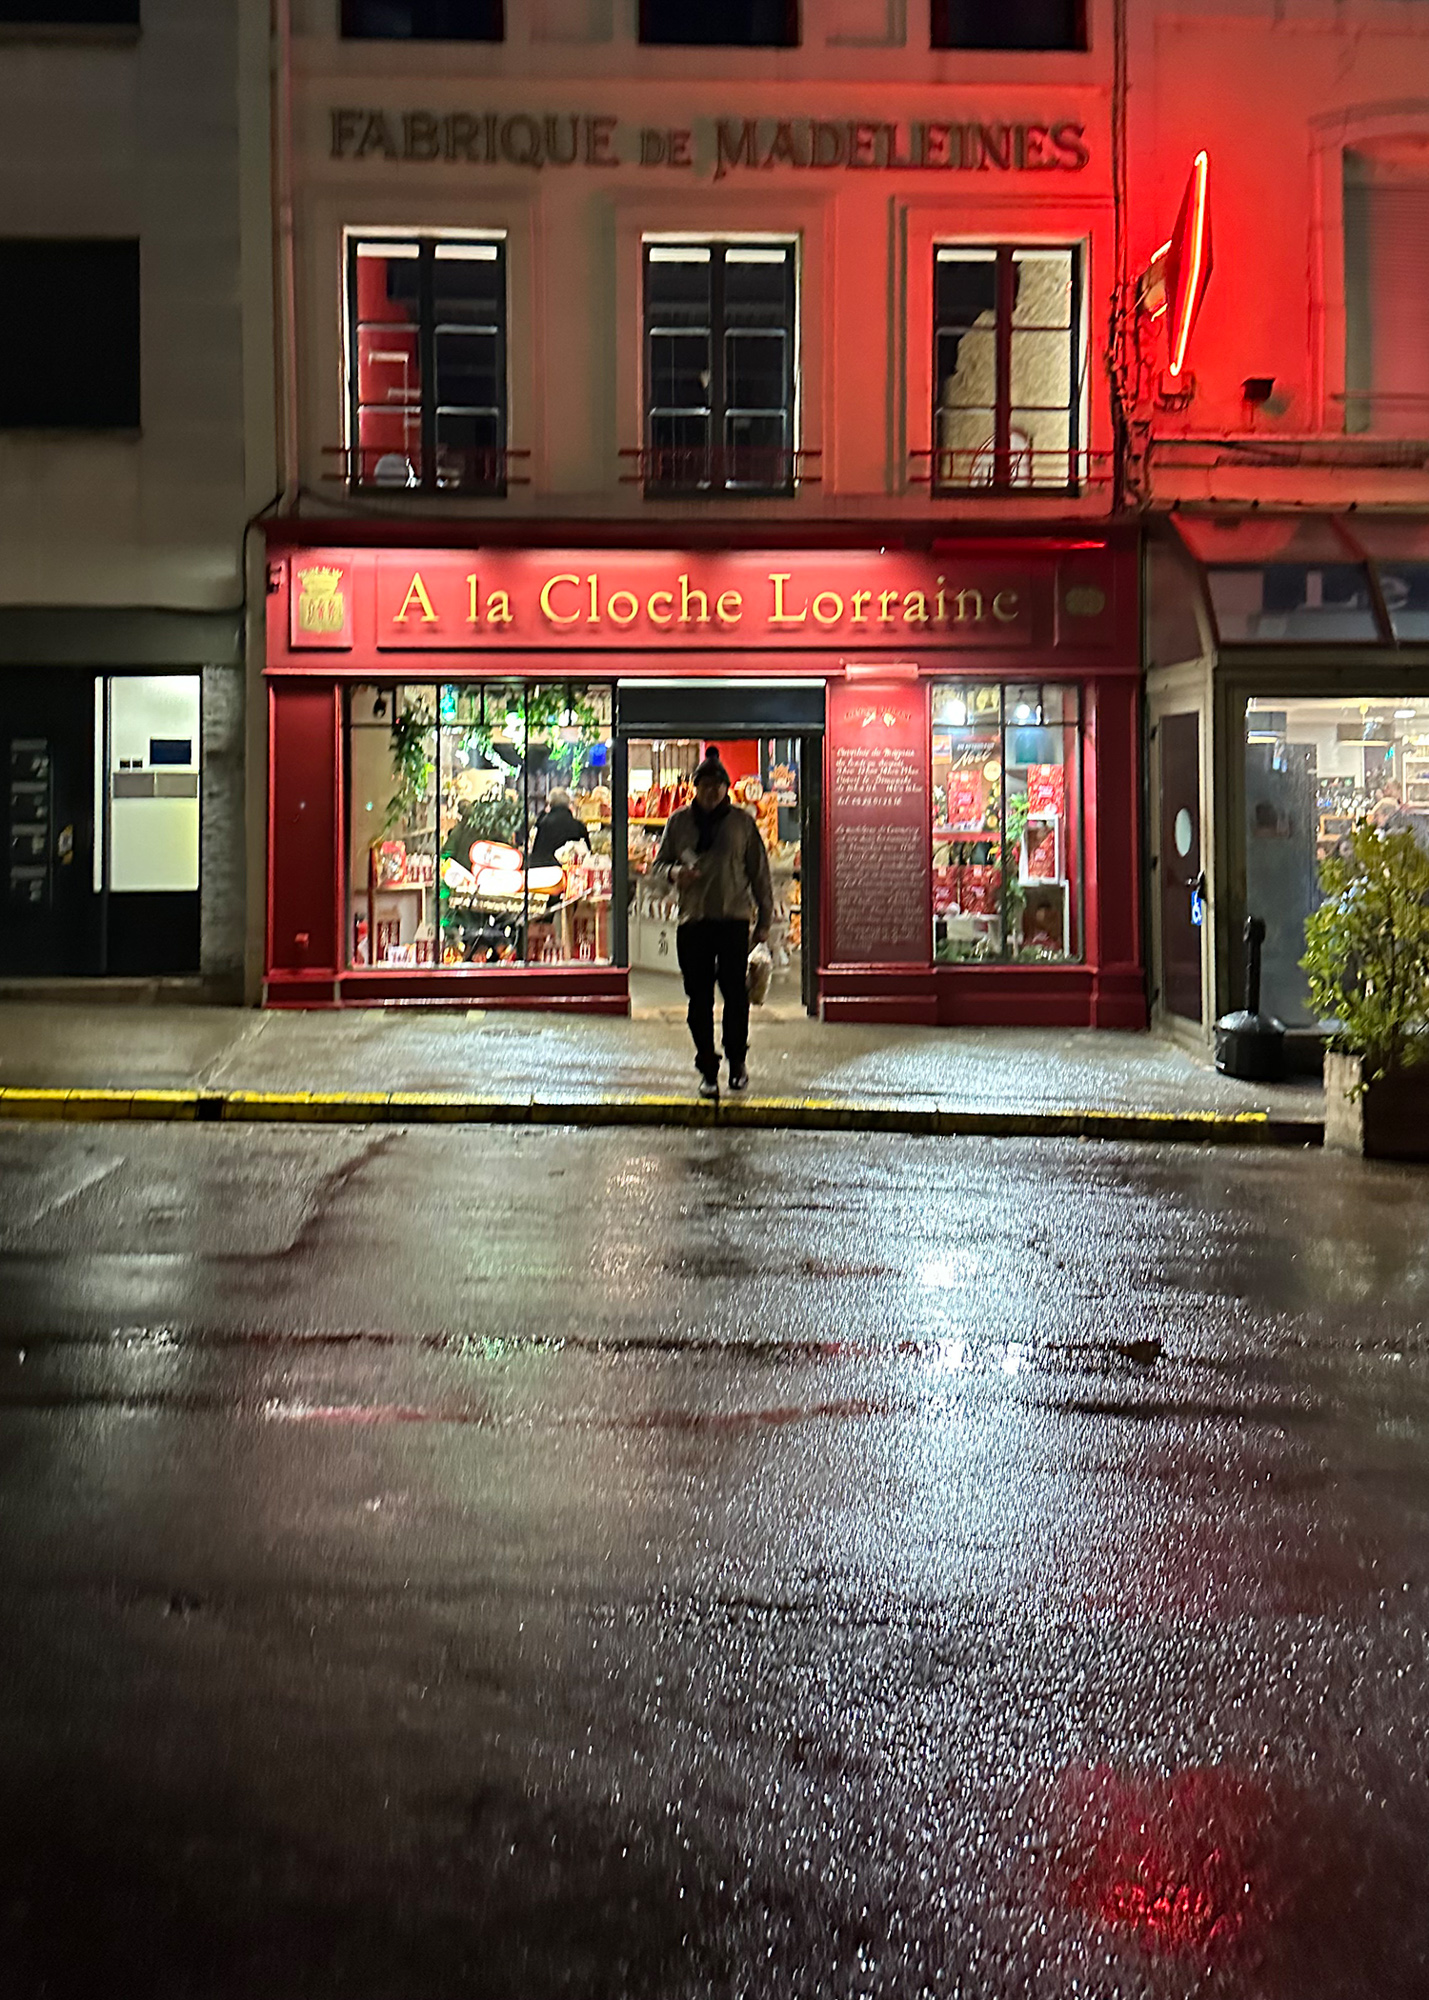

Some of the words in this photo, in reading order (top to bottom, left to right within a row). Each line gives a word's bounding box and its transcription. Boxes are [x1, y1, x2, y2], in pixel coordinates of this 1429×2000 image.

[330, 108, 619, 172] FABRIQUE
[639, 127, 692, 168] DE
[713, 119, 1090, 181] MADELEINES
[393, 572, 440, 622] A
[466, 573, 513, 624] la
[540, 573, 743, 624] Cloche
[768, 573, 1019, 624] Lorraine
